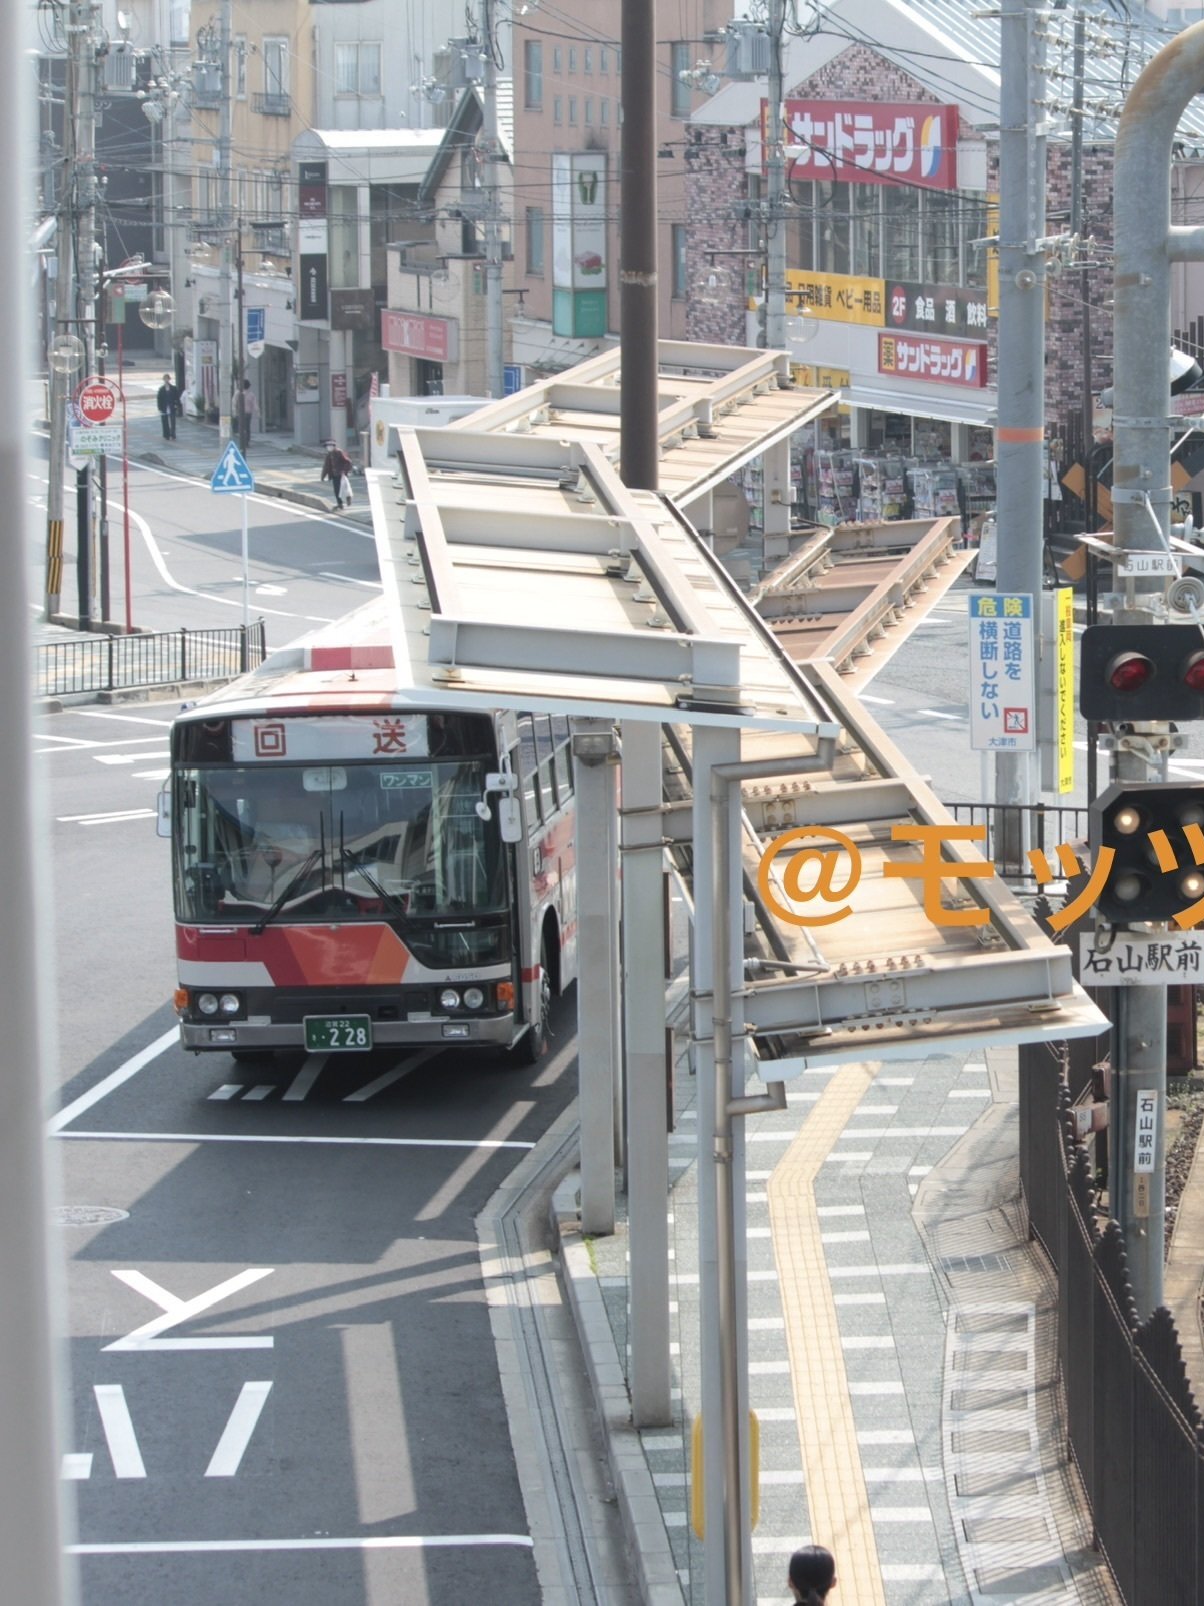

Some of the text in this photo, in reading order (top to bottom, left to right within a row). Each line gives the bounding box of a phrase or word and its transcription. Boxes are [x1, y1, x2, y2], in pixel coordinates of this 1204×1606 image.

[791, 112, 916, 173] サンドラッグ
[836, 288, 882, 313] ベビー用品
[892, 296, 987, 327] 2F 食品 酒 飲料
[896, 342, 962, 378] サンドラッグ
[83, 395, 113, 410] 消火栓
[977, 597, 1023, 617] 危険
[1003, 622, 1022, 681] 道路を
[980, 621, 999, 720] 横断しない
[988, 737, 1017, 747] 大津市
[383, 775, 431, 787] ワンマン
[1083, 939, 1203, 974] 石山駅前
[1138, 1098, 1155, 1165] 石山駅前
